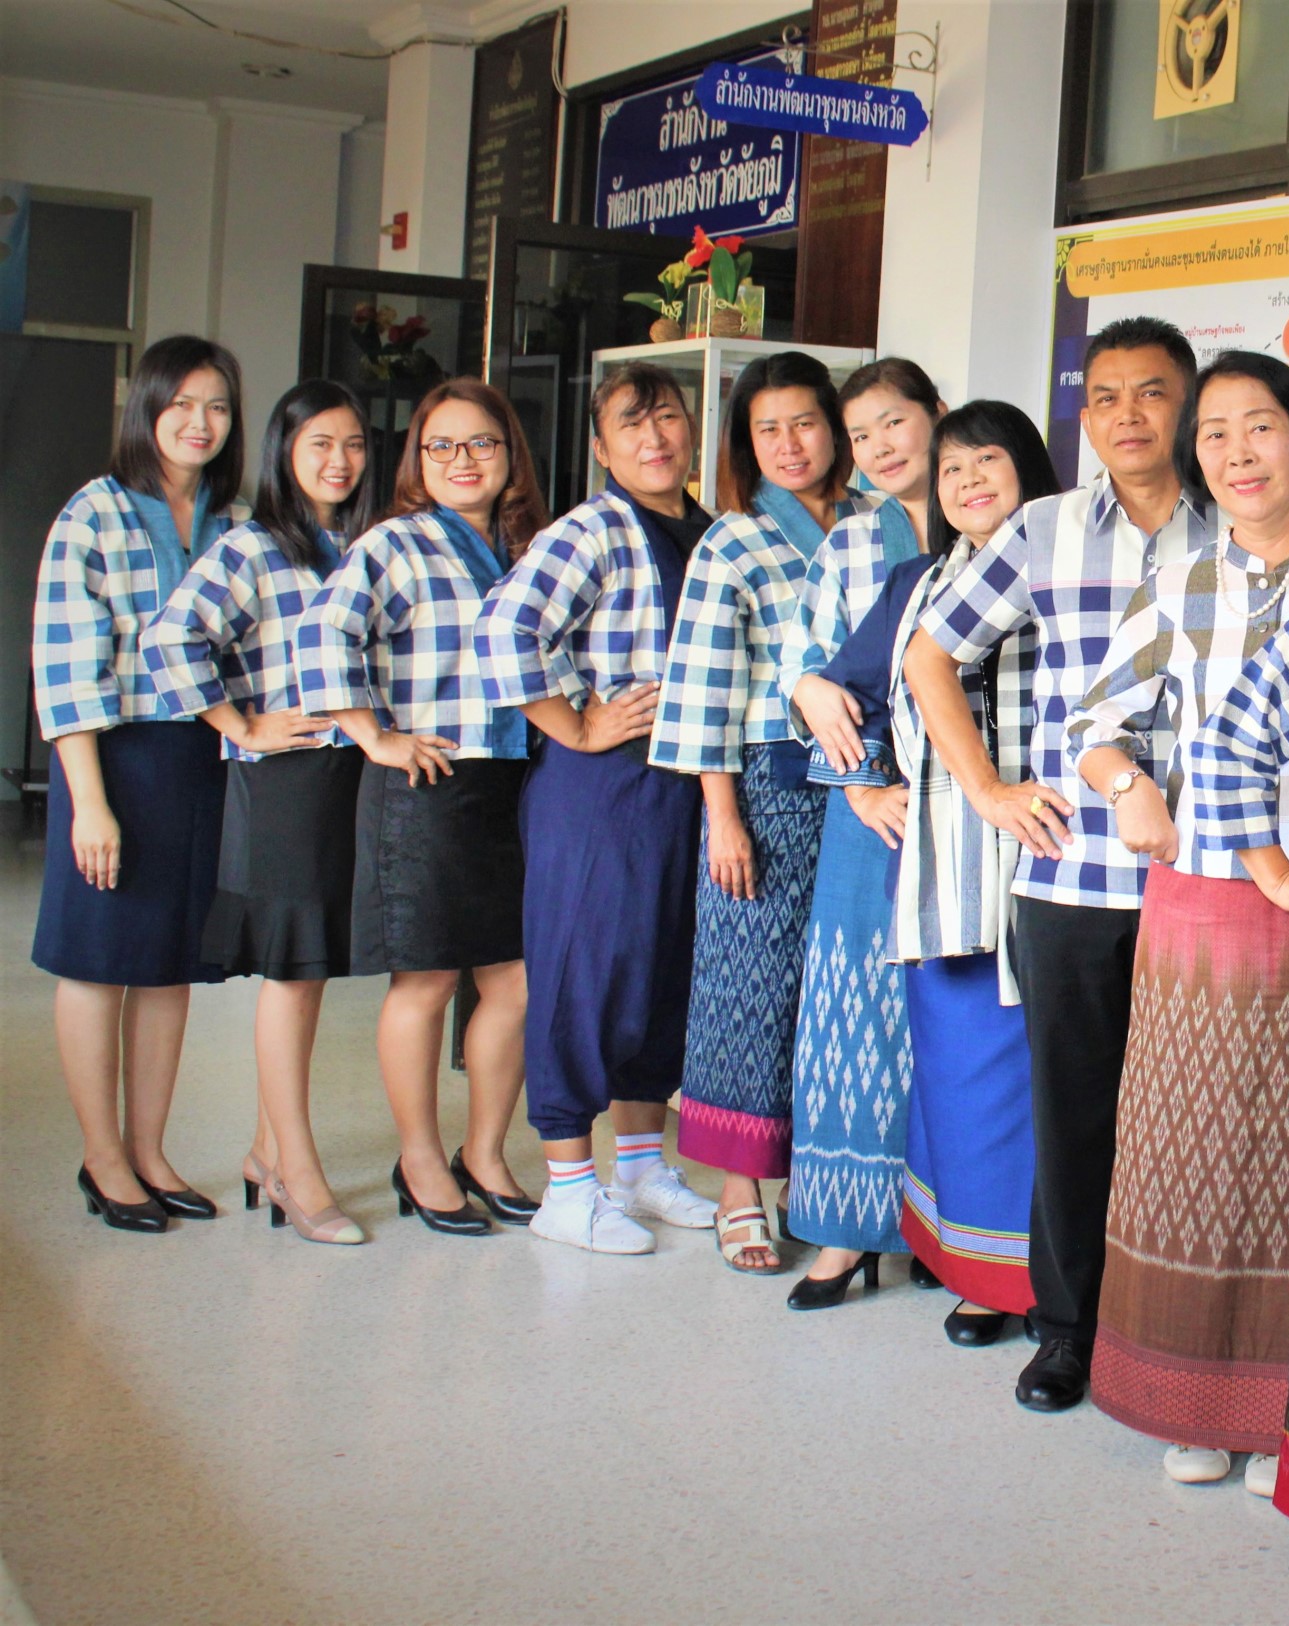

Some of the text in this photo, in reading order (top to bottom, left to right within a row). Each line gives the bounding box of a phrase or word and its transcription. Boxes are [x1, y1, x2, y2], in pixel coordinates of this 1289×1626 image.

[715, 69, 907, 134] สำนักงานพัฒนาชุมชนจังหวัด
[607, 135, 783, 235] พัฒนาชุมชนจังหวัดชัยภูมิ
